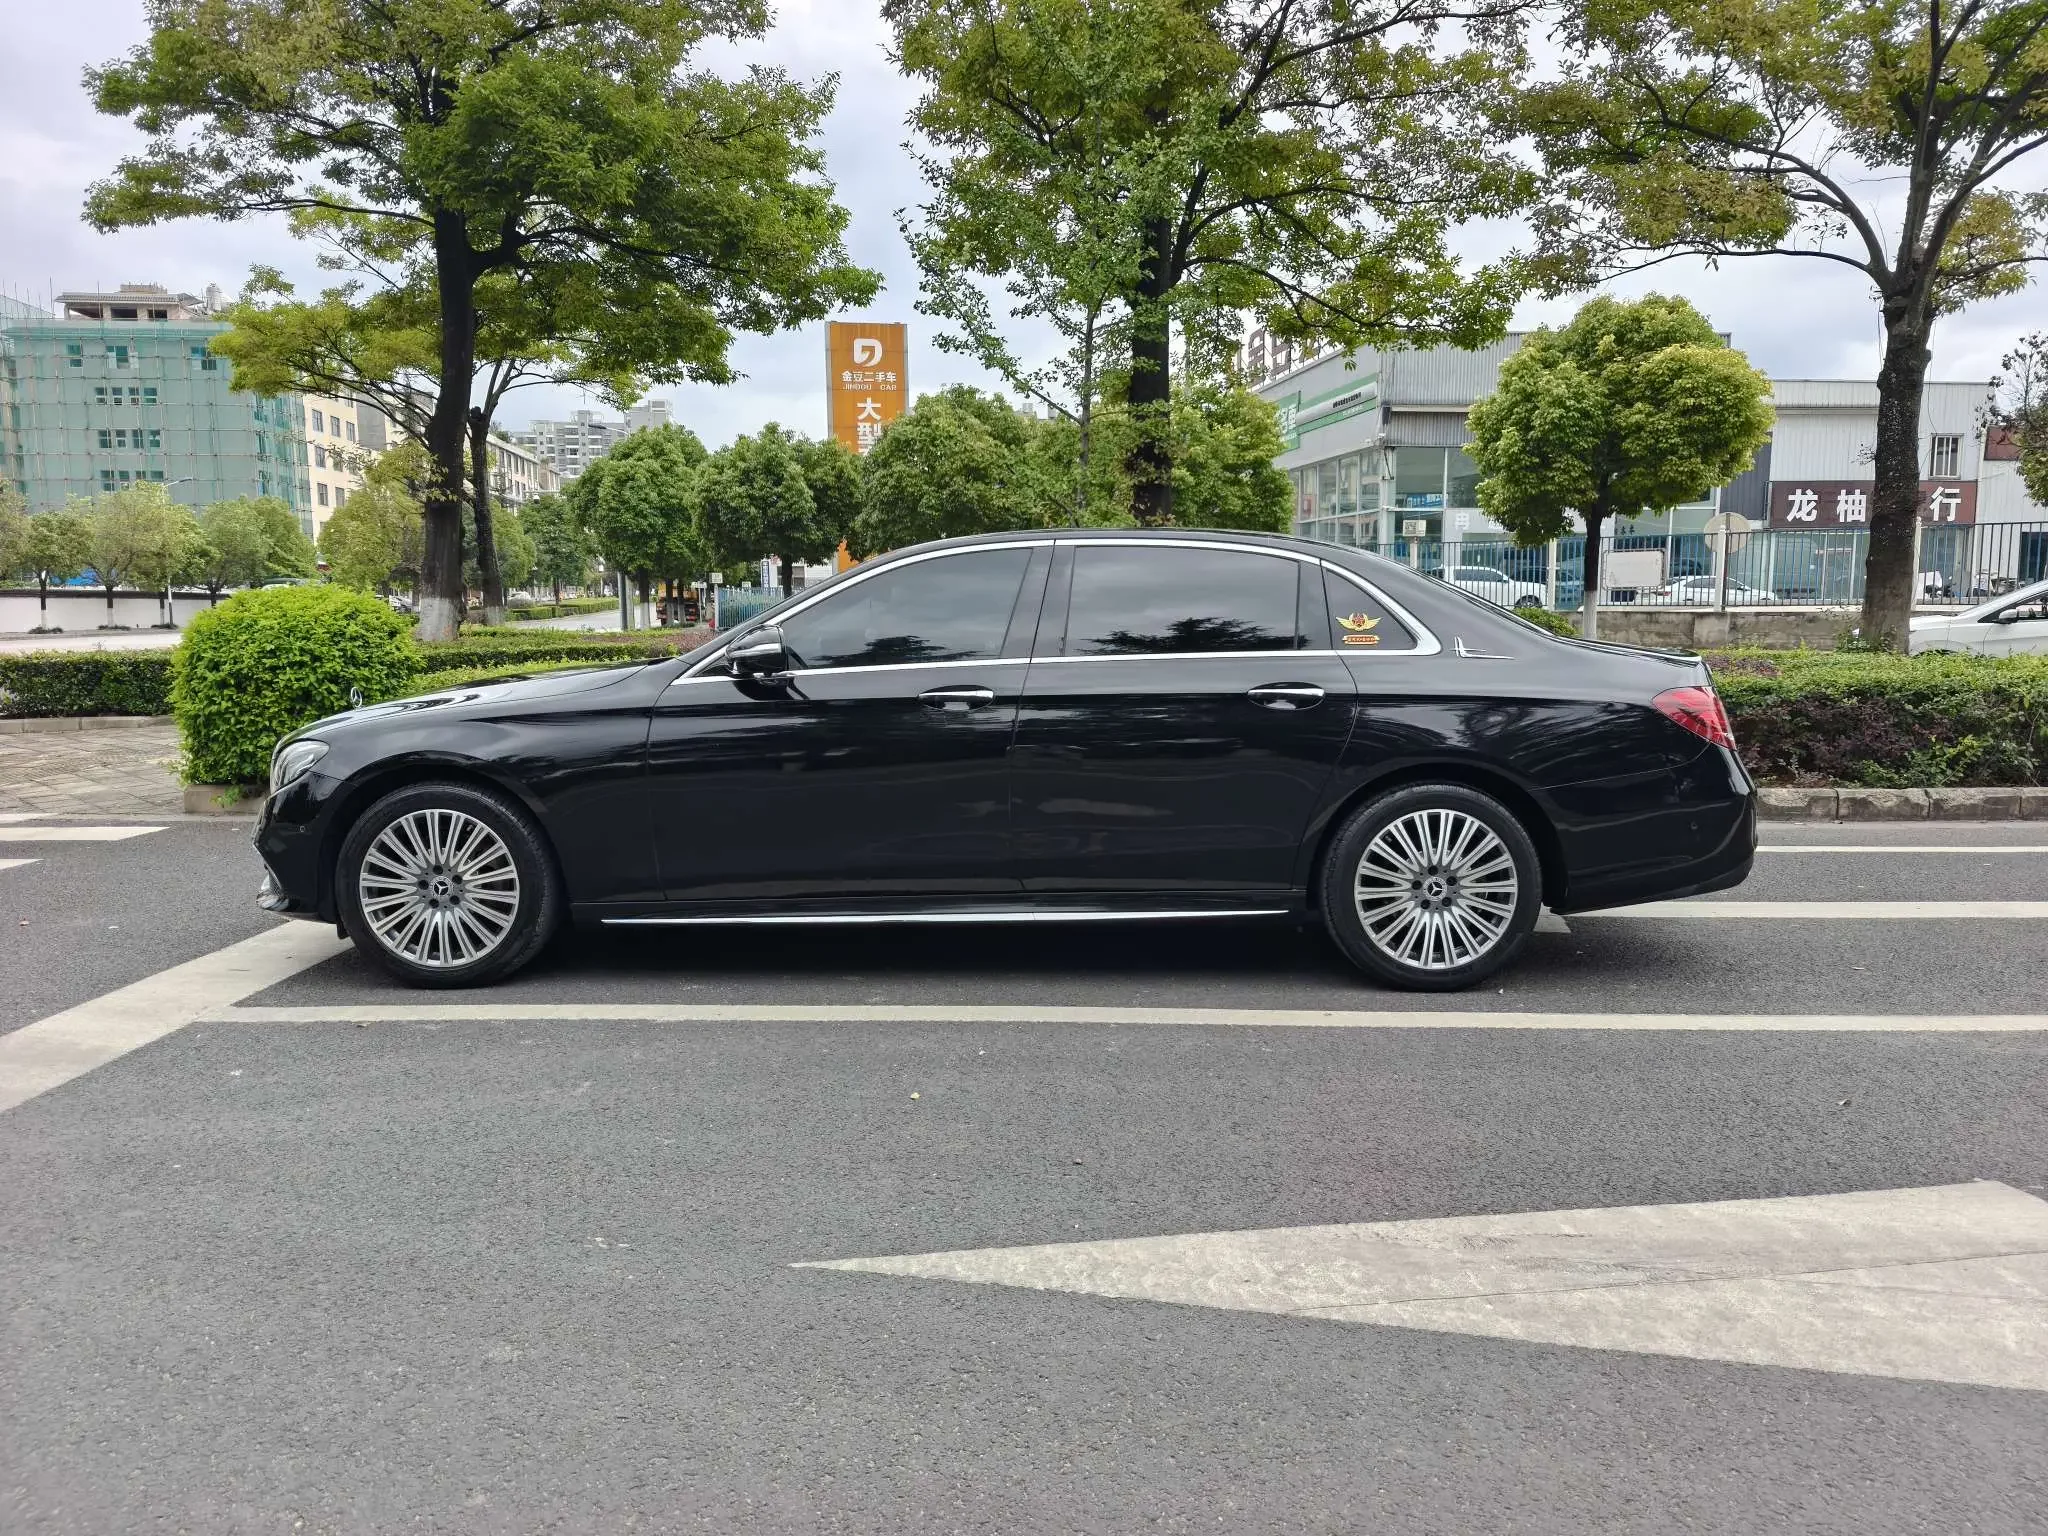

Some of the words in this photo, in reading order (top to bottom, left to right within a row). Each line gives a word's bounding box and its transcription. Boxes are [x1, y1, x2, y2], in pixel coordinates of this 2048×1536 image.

[842, 371, 897, 383] 金豆二手车
[857, 397, 882, 456] 大型
[1787, 486, 1961, 522] 龙柚行
